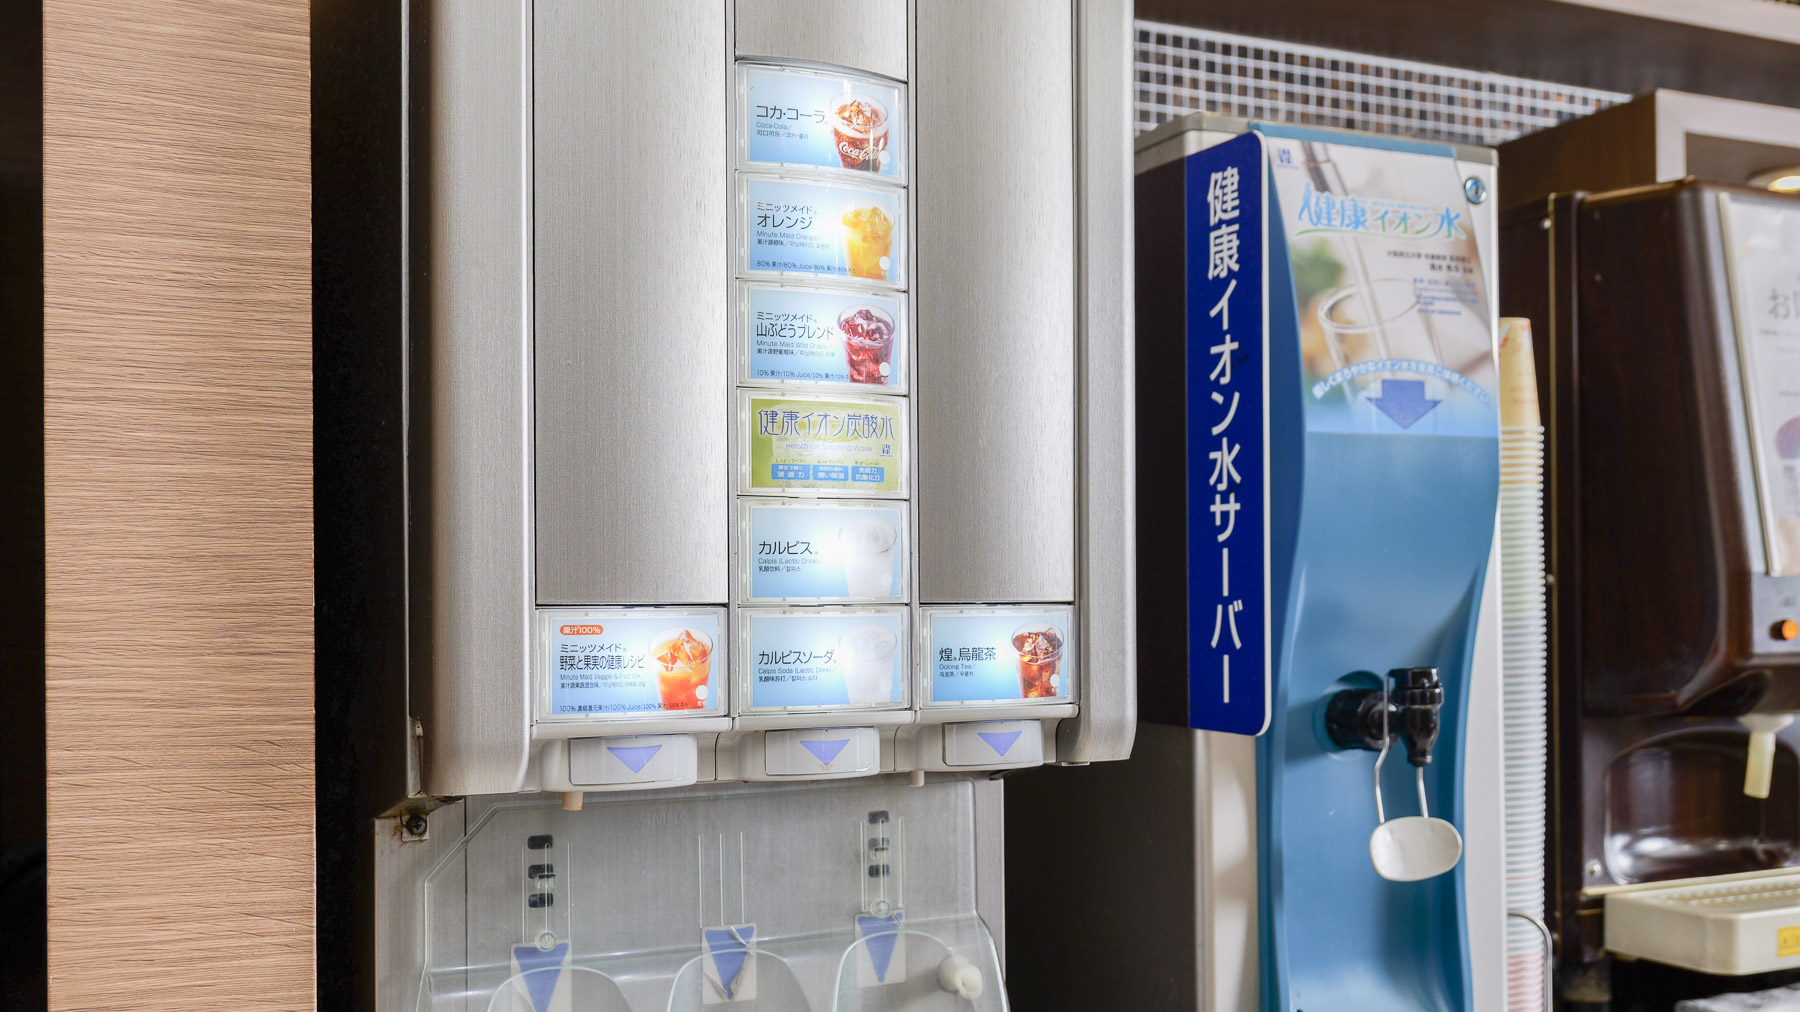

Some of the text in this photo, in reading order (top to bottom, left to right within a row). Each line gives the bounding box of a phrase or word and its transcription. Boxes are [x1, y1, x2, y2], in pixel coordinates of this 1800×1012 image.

[1298, 181, 1466, 239] 健康イオン水
[757, 214, 814, 230] オレンジ
[780, 232, 795, 240] Maid
[756, 322, 834, 340] 山ぶどうブレンド
[795, 341, 809, 349] Wild
[758, 409, 895, 441] 健康イオン炭酸水
[1207, 166, 1243, 703] 健康イオン水サーバー
[758, 540, 813, 555] カルピス
[563, 626, 601, 635] 果汁100%
[560, 654, 645, 671] 野菜と果実の健康レシピ
[758, 649, 834, 665] カルピスソーダ
[594, 673, 612, 681] Veggie
[758, 667, 777, 675] Calpis
